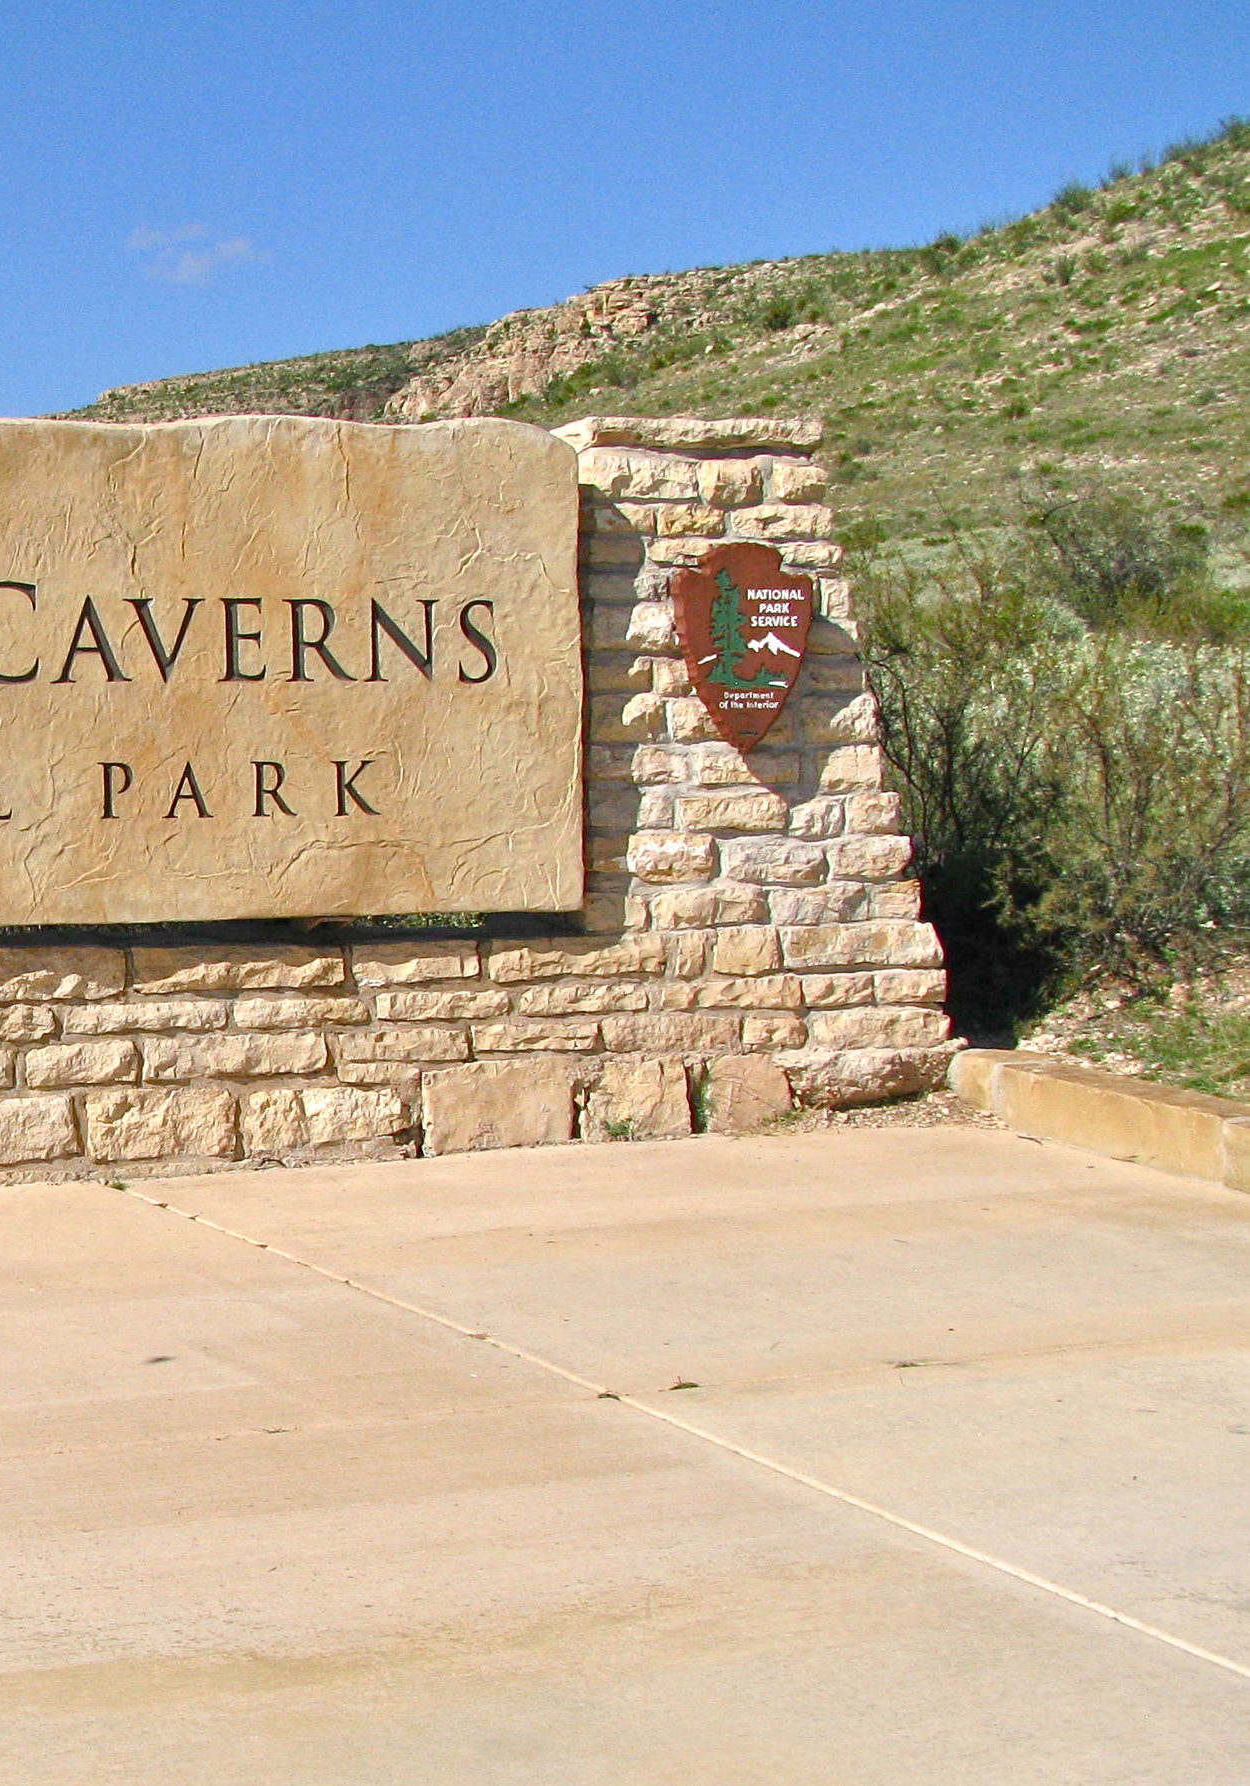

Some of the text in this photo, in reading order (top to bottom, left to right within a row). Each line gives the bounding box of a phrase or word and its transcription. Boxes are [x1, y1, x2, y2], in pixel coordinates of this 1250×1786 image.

[747, 589, 805, 601] NATIONAL
[759, 603, 790, 614] PARK
[750, 616, 798, 627] SERVICE
[723, 691, 774, 700] Department
[719, 700, 779, 709] of the Interior
[97, 759, 381, 820] PARK
